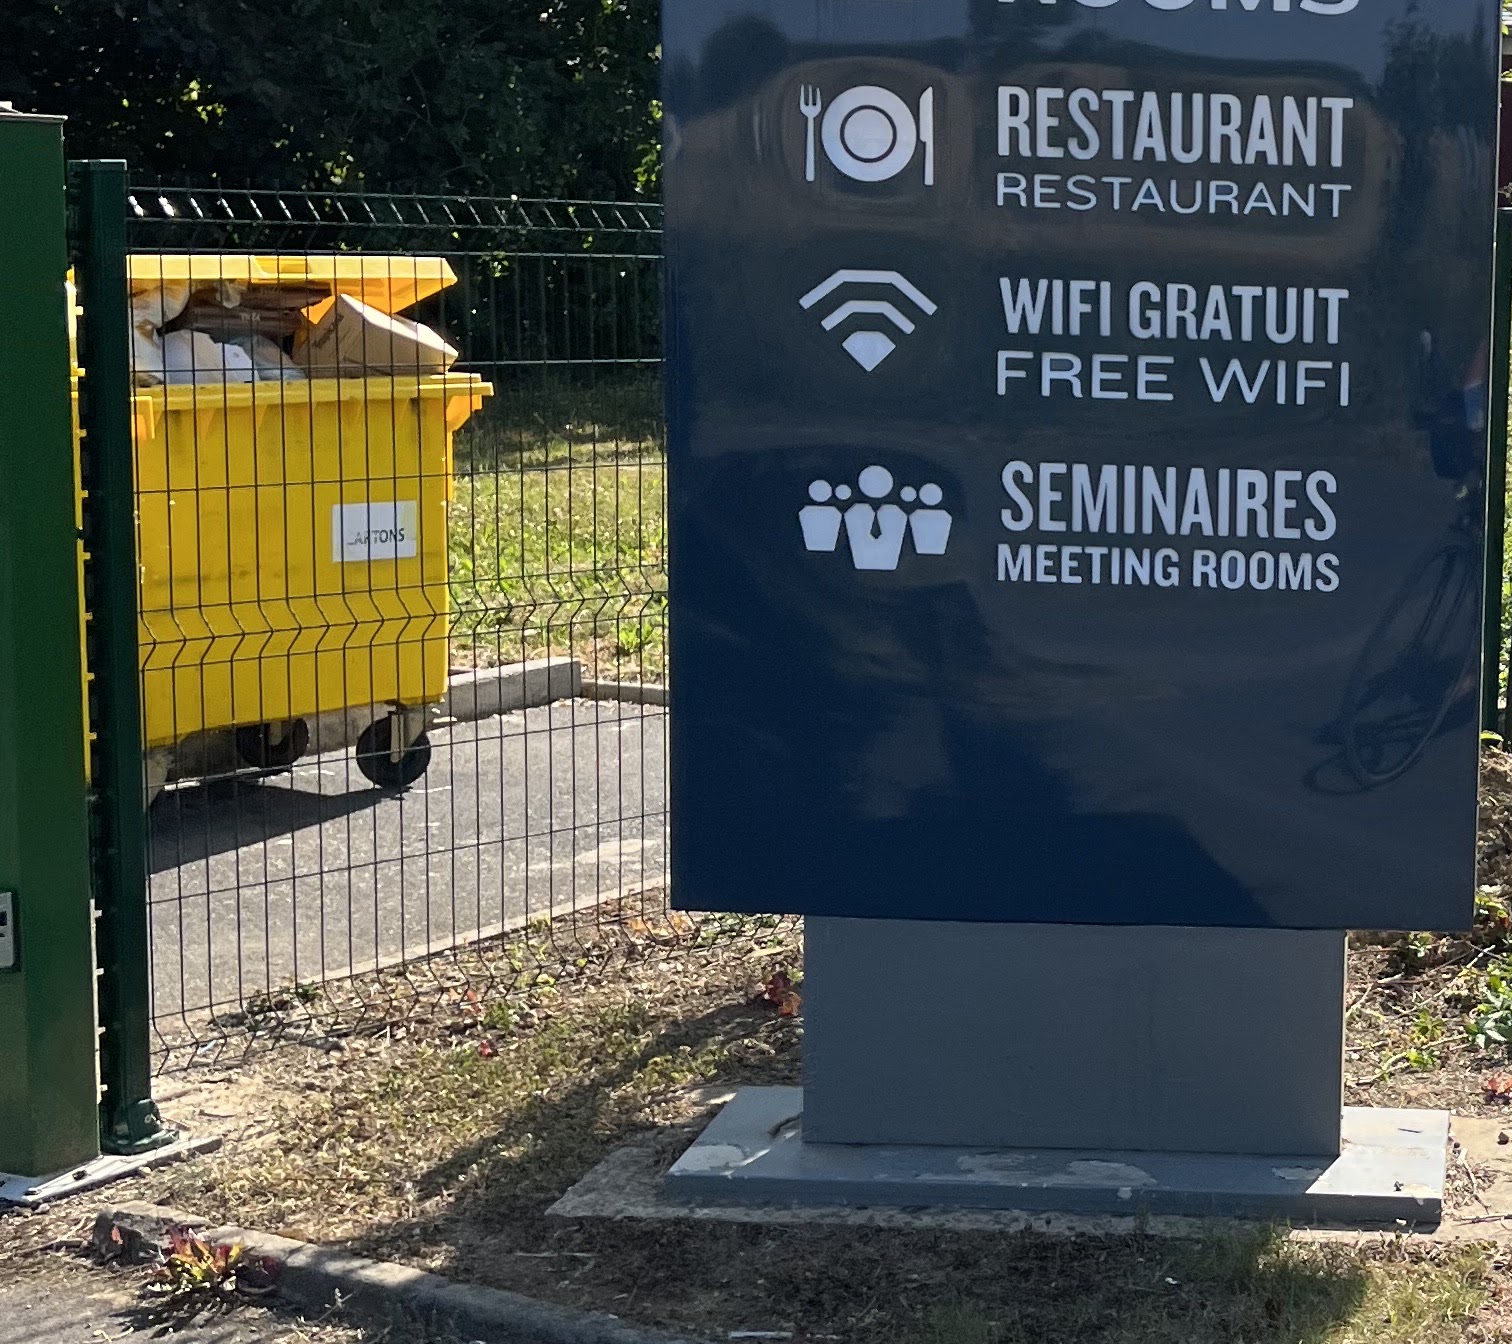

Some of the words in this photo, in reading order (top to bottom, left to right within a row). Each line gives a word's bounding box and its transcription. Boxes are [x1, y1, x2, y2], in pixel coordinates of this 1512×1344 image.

[998, 86, 1353, 167] RESTAURANT
[997, 173, 1351, 217] RESTAURANT
[1000, 277, 1110, 336] WIFI
[1130, 282, 1349, 343] GRATUIT
[998, 351, 1174, 400] FREE
[1200, 358, 1349, 406] WIFI
[1002, 461, 1336, 540] SEMINAIRES
[998, 544, 1179, 586] MEETING
[1193, 550, 1339, 591] ROOMS
